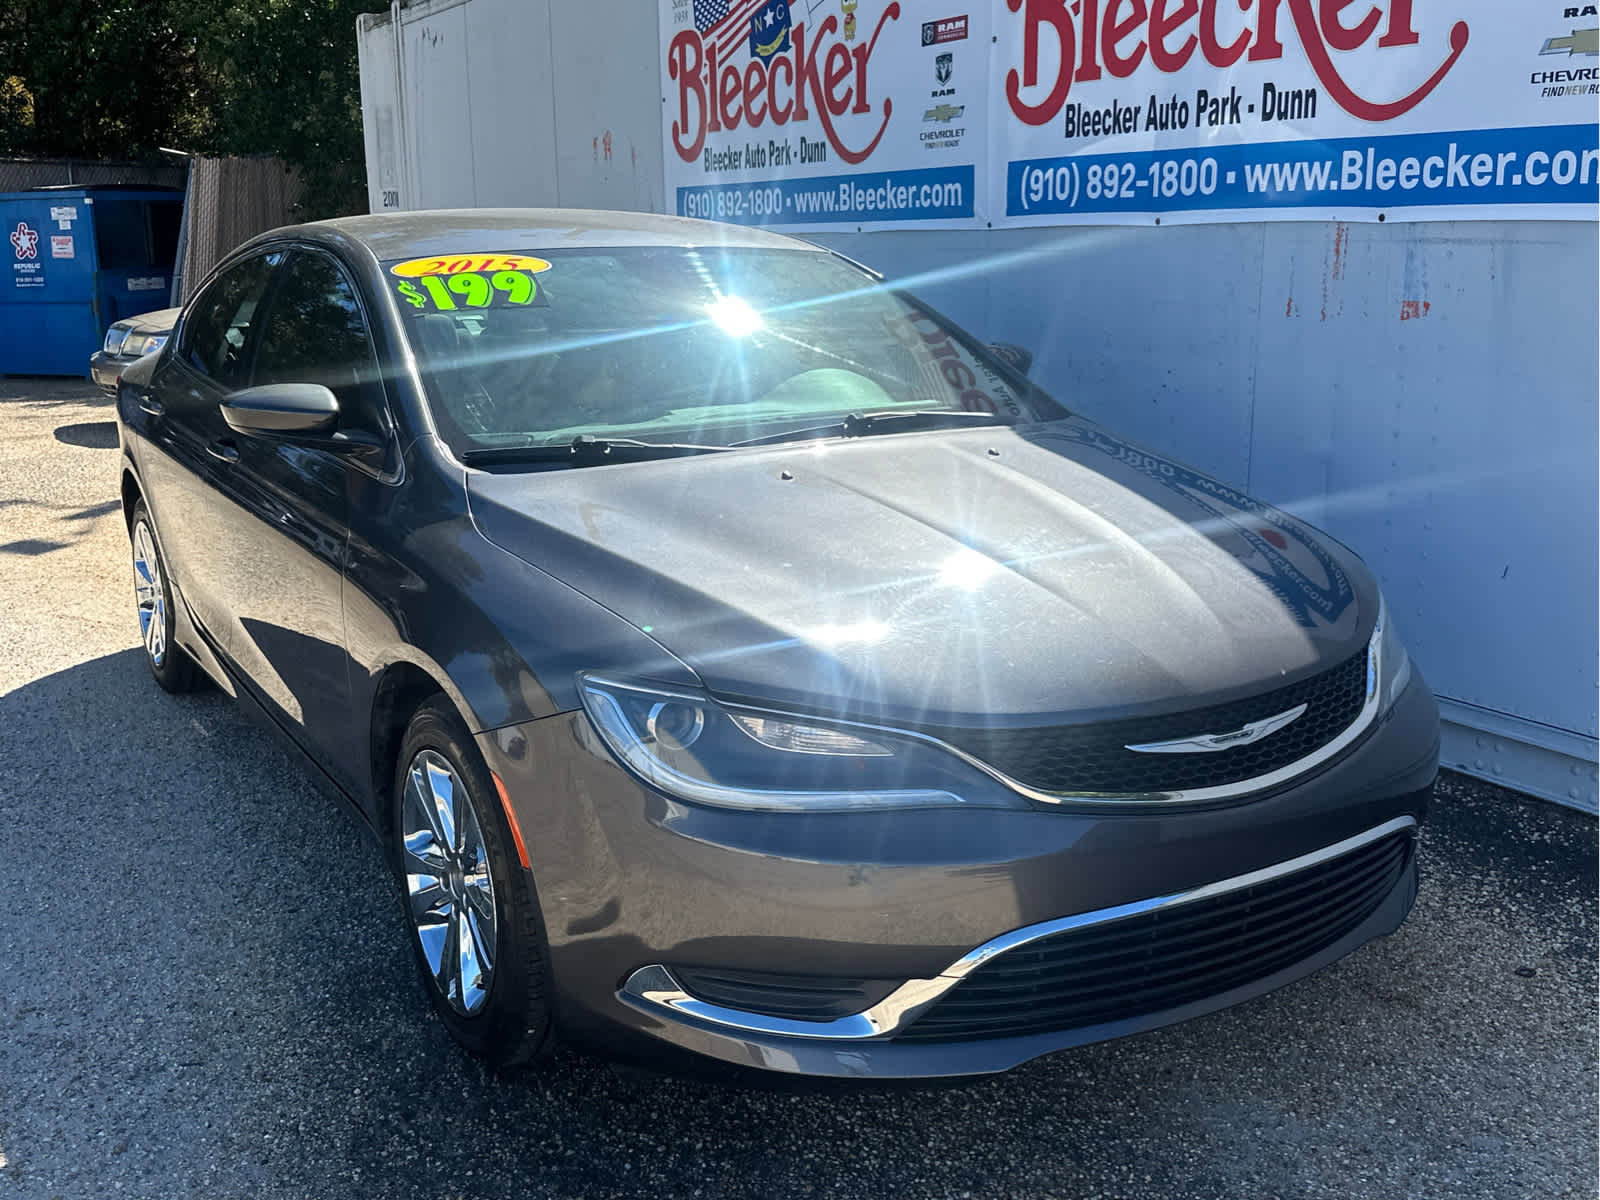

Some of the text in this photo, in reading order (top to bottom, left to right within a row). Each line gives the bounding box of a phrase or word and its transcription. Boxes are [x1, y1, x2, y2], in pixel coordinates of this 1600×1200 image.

[937, 20, 966, 33] RAM
[668, 1, 900, 164] Bleecker
[1006, 0, 1469, 126] Bleecker
[931, 88, 956, 98] RAM
[1065, 82, 1317, 138] Bleecker Auto Park Dunn
[704, 136, 827, 172] Bleecker Auto Park Dunn
[919, 128, 966, 142] CHEVROLET
[683, 179, 962, 219] (910) 892-1800 www.Bleecker.com
[1020, 162, 1080, 210] (910)
[1086, 158, 1218, 199] 892-1800
[419, 258, 523, 277] 2015
[398, 269, 537, 311] $199
